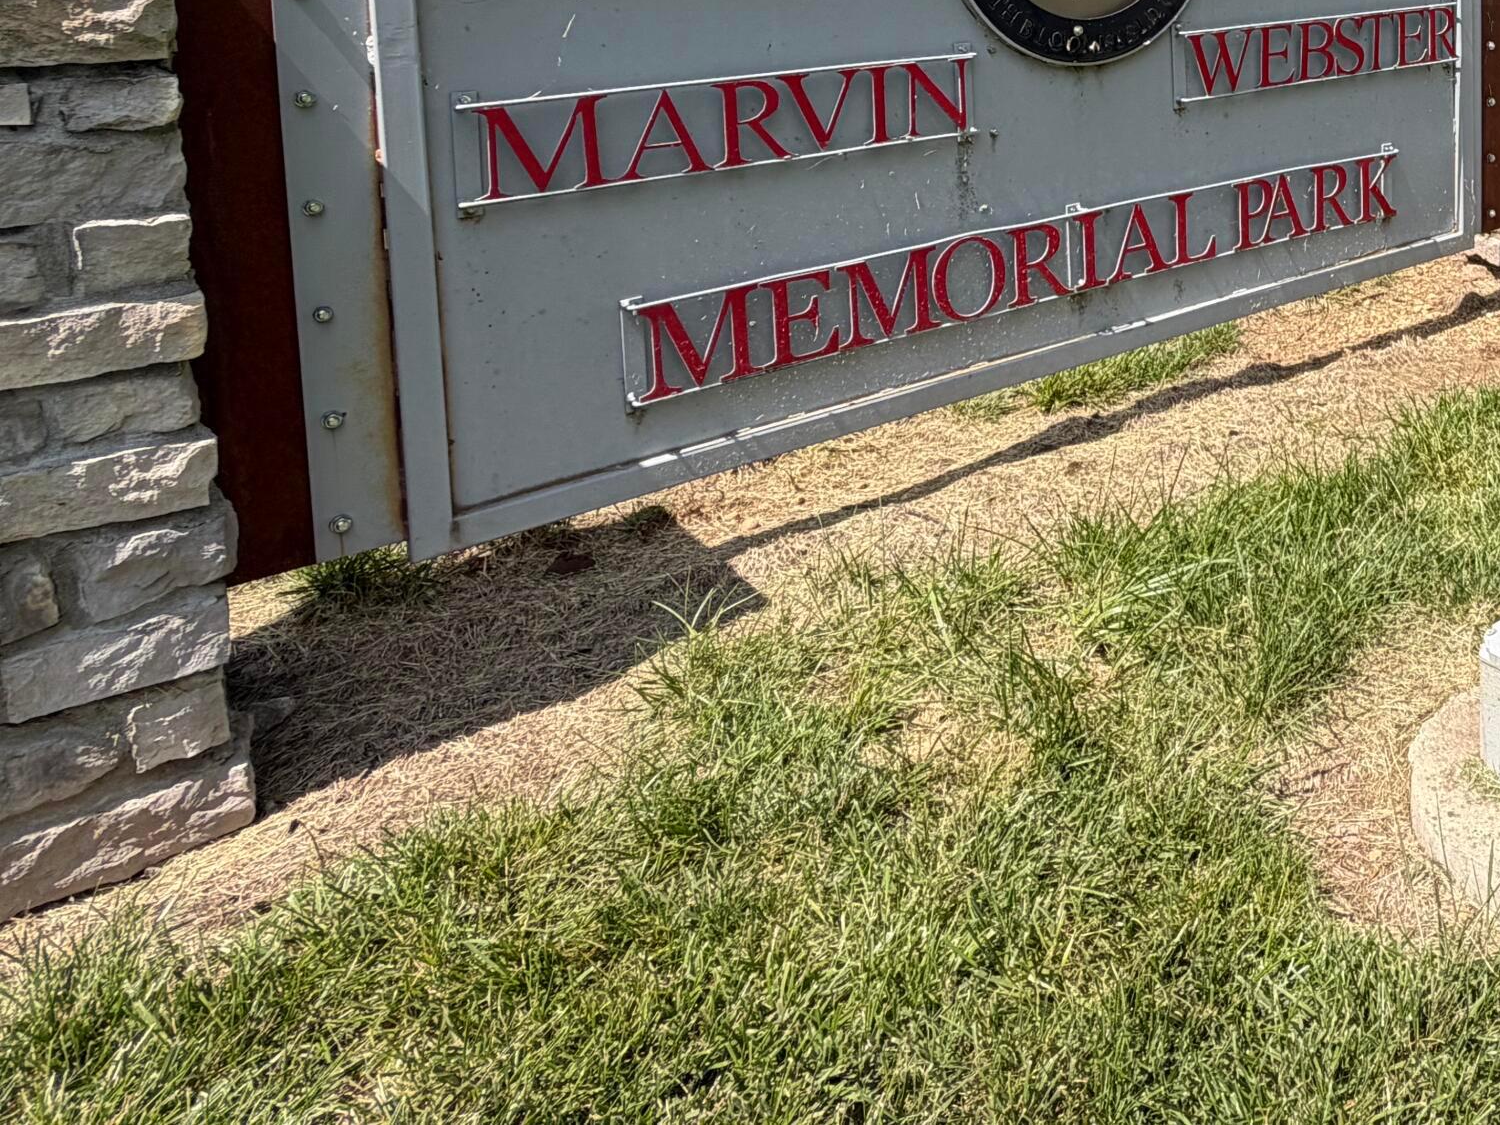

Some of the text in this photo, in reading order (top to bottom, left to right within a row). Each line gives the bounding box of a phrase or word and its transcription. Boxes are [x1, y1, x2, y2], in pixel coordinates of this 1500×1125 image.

[473, 7, 1457, 201] MARVIN WEBSTER
[638, 156, 1398, 402] MEMORIAL PARK
